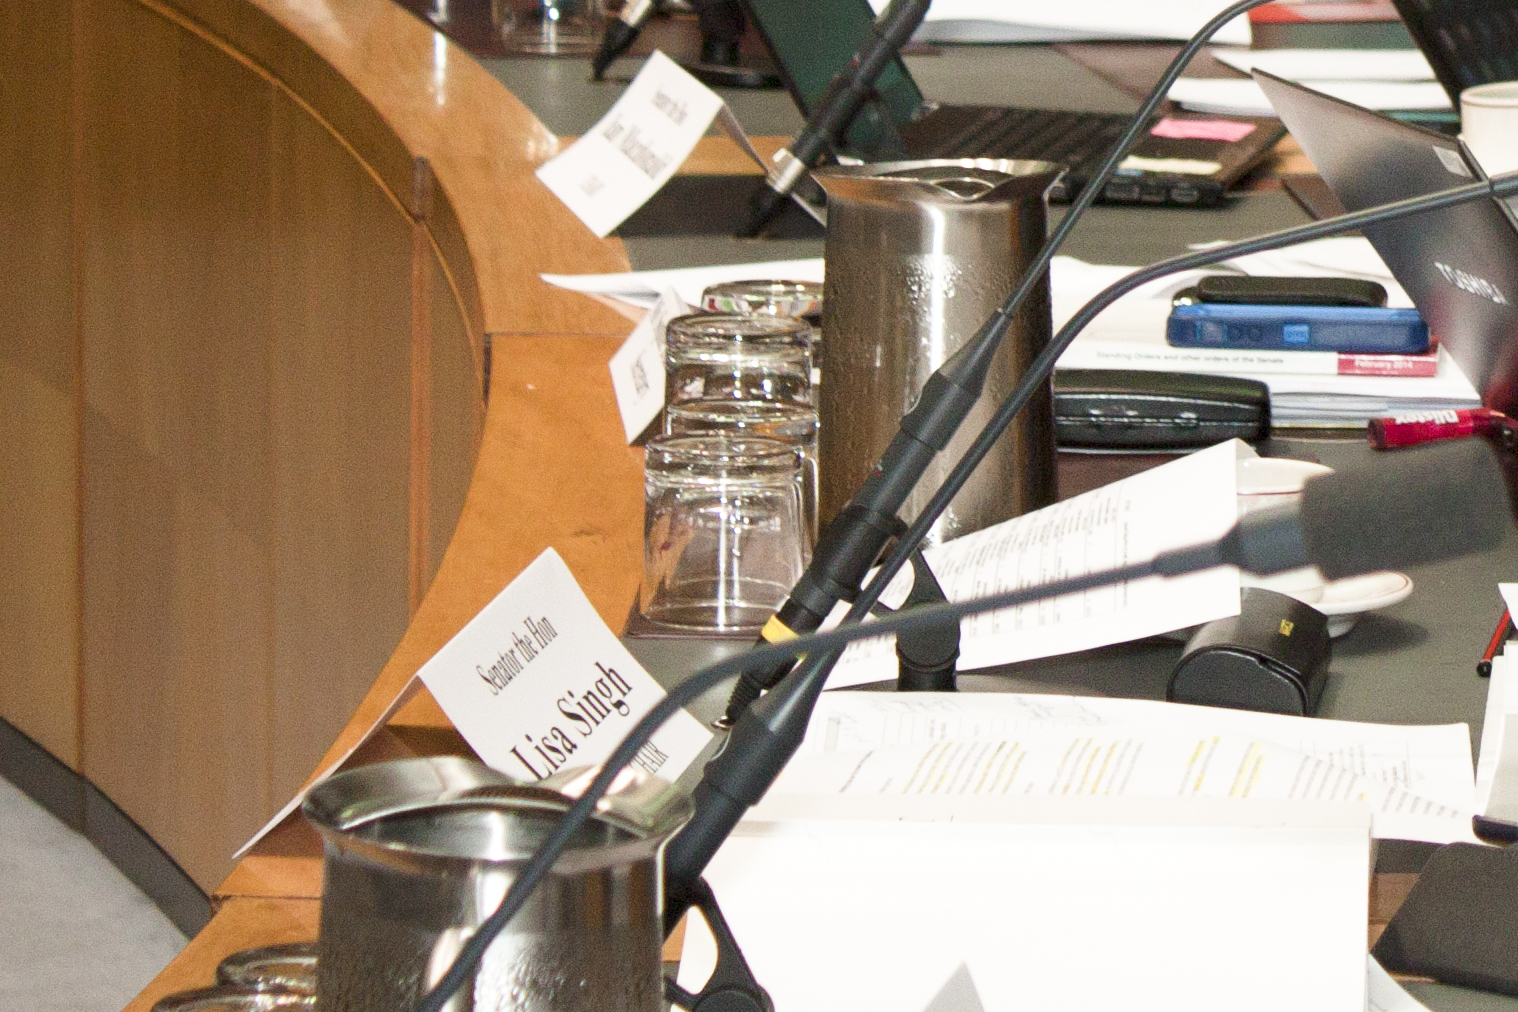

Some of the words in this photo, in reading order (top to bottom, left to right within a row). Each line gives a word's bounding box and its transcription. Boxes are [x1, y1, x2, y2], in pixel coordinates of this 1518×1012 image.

[1433, 261, 1508, 305] TOSHIBA
[1354, 359, 1392, 370] February
[511, 631, 539, 663] the
[523, 615, 558, 649] Hon
[475, 649, 524, 696] Senator
[510, 726, 578, 781] Lisa
[556, 661, 633, 738] Singh
[629, 739, 669, 775] HAIR
